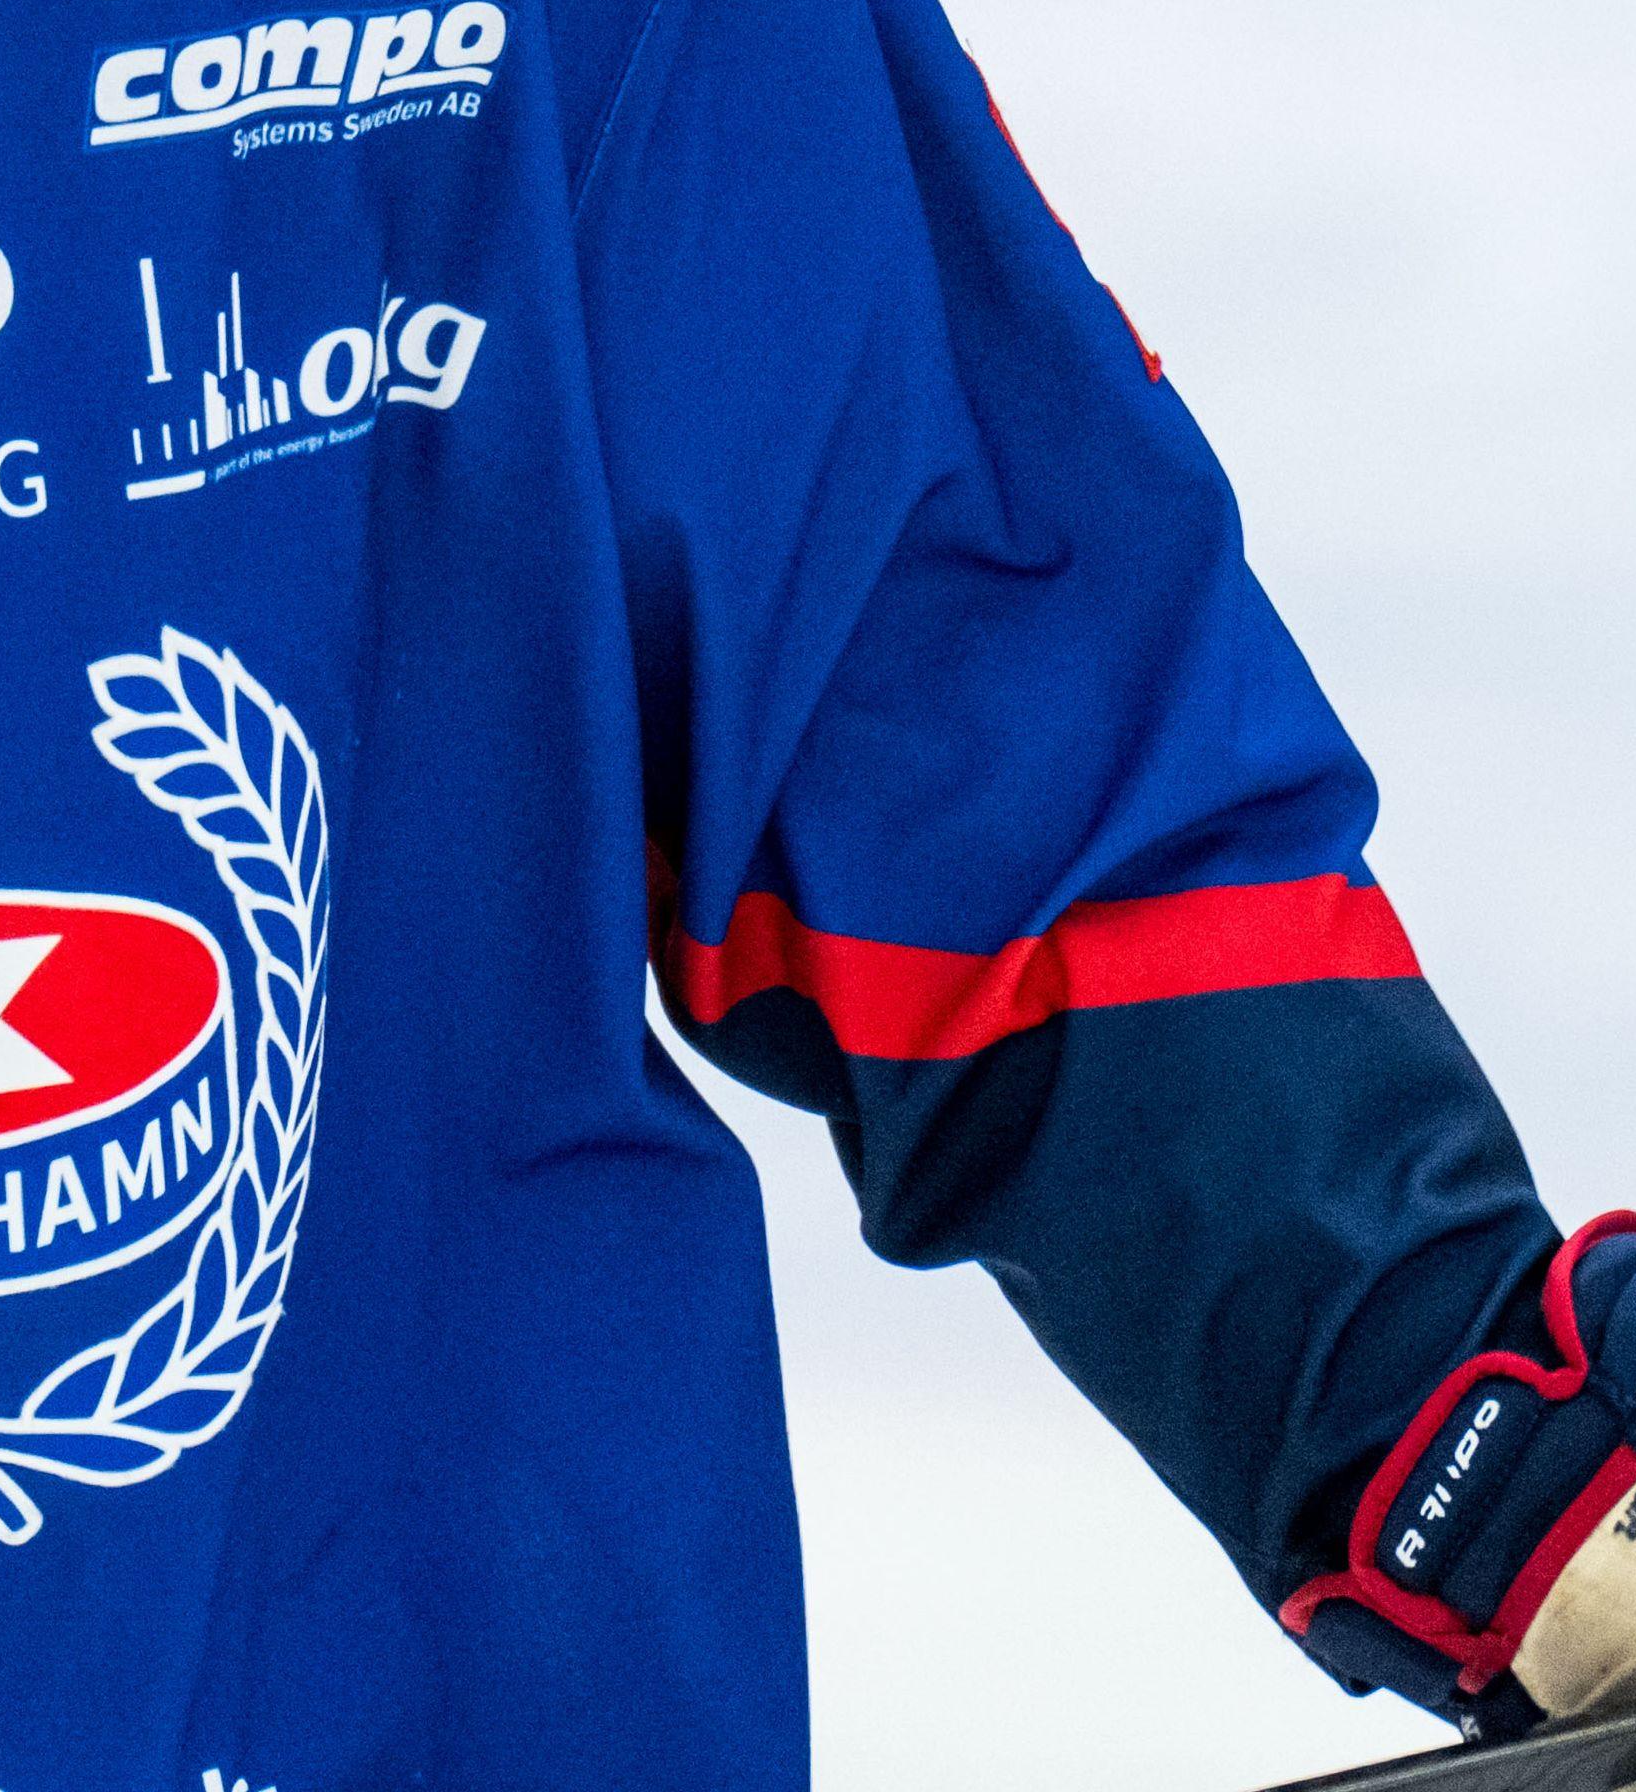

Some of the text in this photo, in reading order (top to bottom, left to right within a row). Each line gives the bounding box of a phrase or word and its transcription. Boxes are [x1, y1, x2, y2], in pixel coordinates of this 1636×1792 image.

[94, 0, 508, 127] compo
[232, 91, 482, 161] Systems Sweden AB
